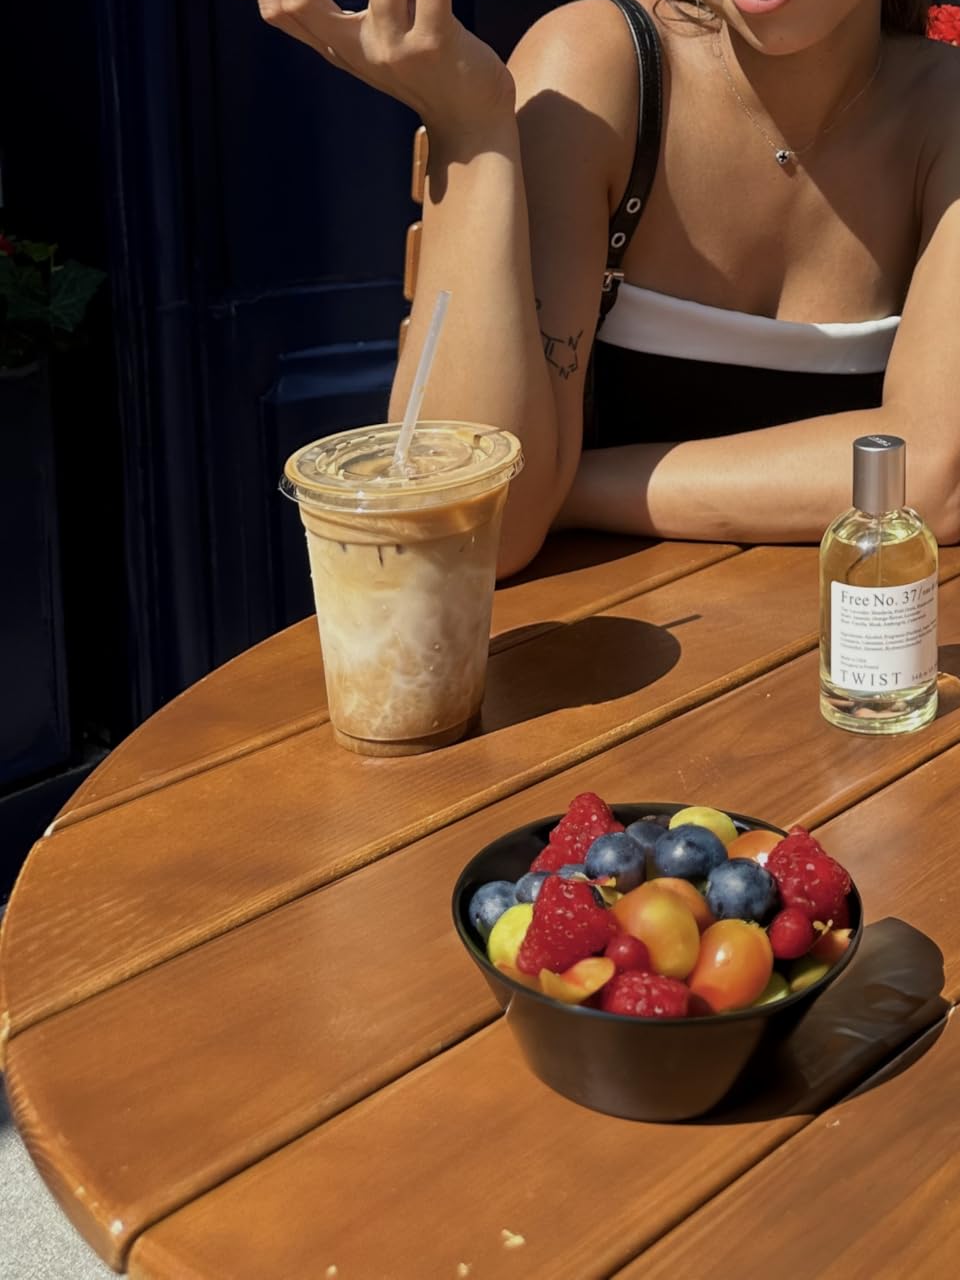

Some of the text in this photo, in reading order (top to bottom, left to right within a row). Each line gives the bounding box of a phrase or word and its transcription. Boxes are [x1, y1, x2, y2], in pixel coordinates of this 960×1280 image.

[841, 590, 870, 607] Free
[873, 593, 898, 607] No.
[840, 670, 902, 687] TWIST
